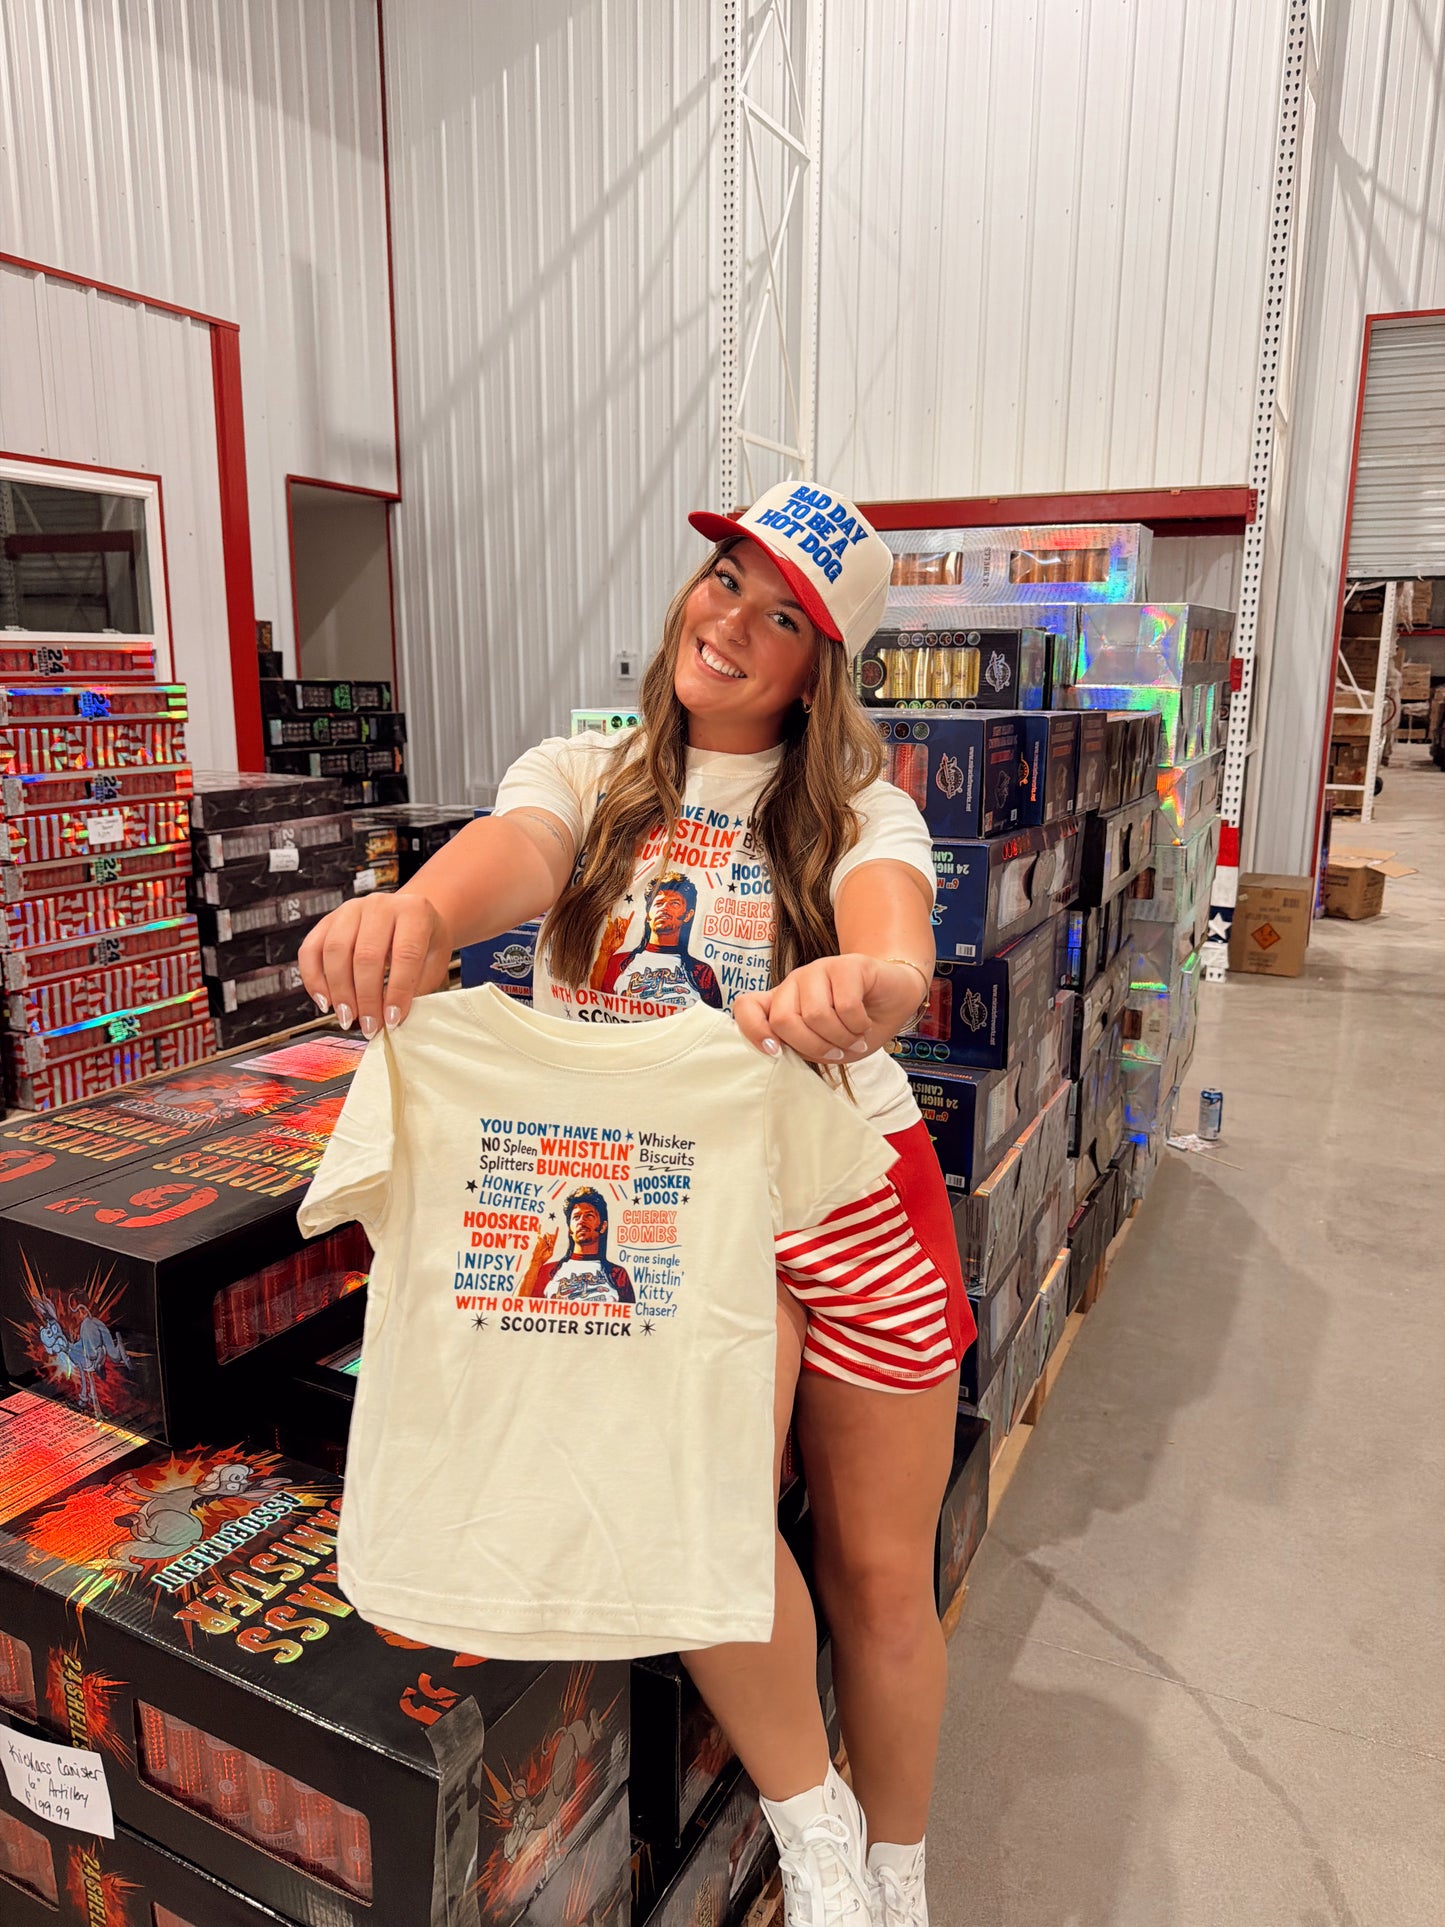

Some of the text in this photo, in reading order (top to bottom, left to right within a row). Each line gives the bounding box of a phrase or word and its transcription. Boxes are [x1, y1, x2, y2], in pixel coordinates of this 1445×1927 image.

[790, 486, 869, 546] BAD DAY
[780, 499, 849, 560] TO BE A
[755, 509, 843, 584] HOT DOG
[48, 649, 65, 674] 24
[92, 693, 110, 718] 24
[103, 776, 118, 800] 24
[706, 809, 729, 829] NO
[103, 857, 118, 883] 24
[956, 863, 970, 875] 24
[740, 879, 774, 896] DOO
[287, 898, 302, 922] 24
[714, 897, 773, 918] CHERR
[106, 938, 121, 963] 24
[704, 943, 721, 960] Or
[722, 951, 743, 965] one
[575, 989, 600, 1006] OR
[600, 993, 678, 1019] WITHOUT
[946, 1097, 959, 1110] 24
[52, 1107, 191, 1145] CANISTER
[480, 1118, 622, 1142] YOU DON'T HAVE NO
[2, 1120, 149, 1162] KICKASS
[481, 1137, 538, 1156] NO Spleen
[540, 1137, 635, 1162] WHISTLIN'
[638, 1131, 696, 1151] Whisker
[201, 1135, 325, 1173] ANISTER
[479, 1155, 534, 1173] Splitters
[639, 1149, 695, 1167] Biscuits
[152, 1151, 313, 1198] KICKASS
[536, 1158, 631, 1181] BUNCHOLES
[481, 1174, 544, 1198] HONKEY
[633, 1175, 691, 1194] HOOSKER
[478, 1191, 546, 1214] LIGHTERS
[643, 1191, 679, 1206] DOOS
[463, 1211, 540, 1233] HOOSKER
[622, 1209, 678, 1225] CHERRY
[471, 1232, 530, 1250] DON'TS
[616, 1225, 678, 1244] BOMBS
[464, 1251, 515, 1272] NIPSY
[618, 1250, 681, 1267] Or one single
[454, 1272, 515, 1292] DAISERS
[633, 1266, 685, 1287] Whistlin'
[638, 1285, 674, 1304] Kitty
[455, 1295, 632, 1318] WITH OR WITHOUT THE
[635, 1301, 678, 1318] Chaser?
[500, 1315, 632, 1337] SCOOTER STICK
[150, 1490, 304, 1594] ASSORTMENT
[173, 1501, 342, 1635] ANISTER
[63, 1654, 83, 1679] 24
[25, 1788, 70, 1821] $199.99
[82, 1852, 101, 1877] 24
